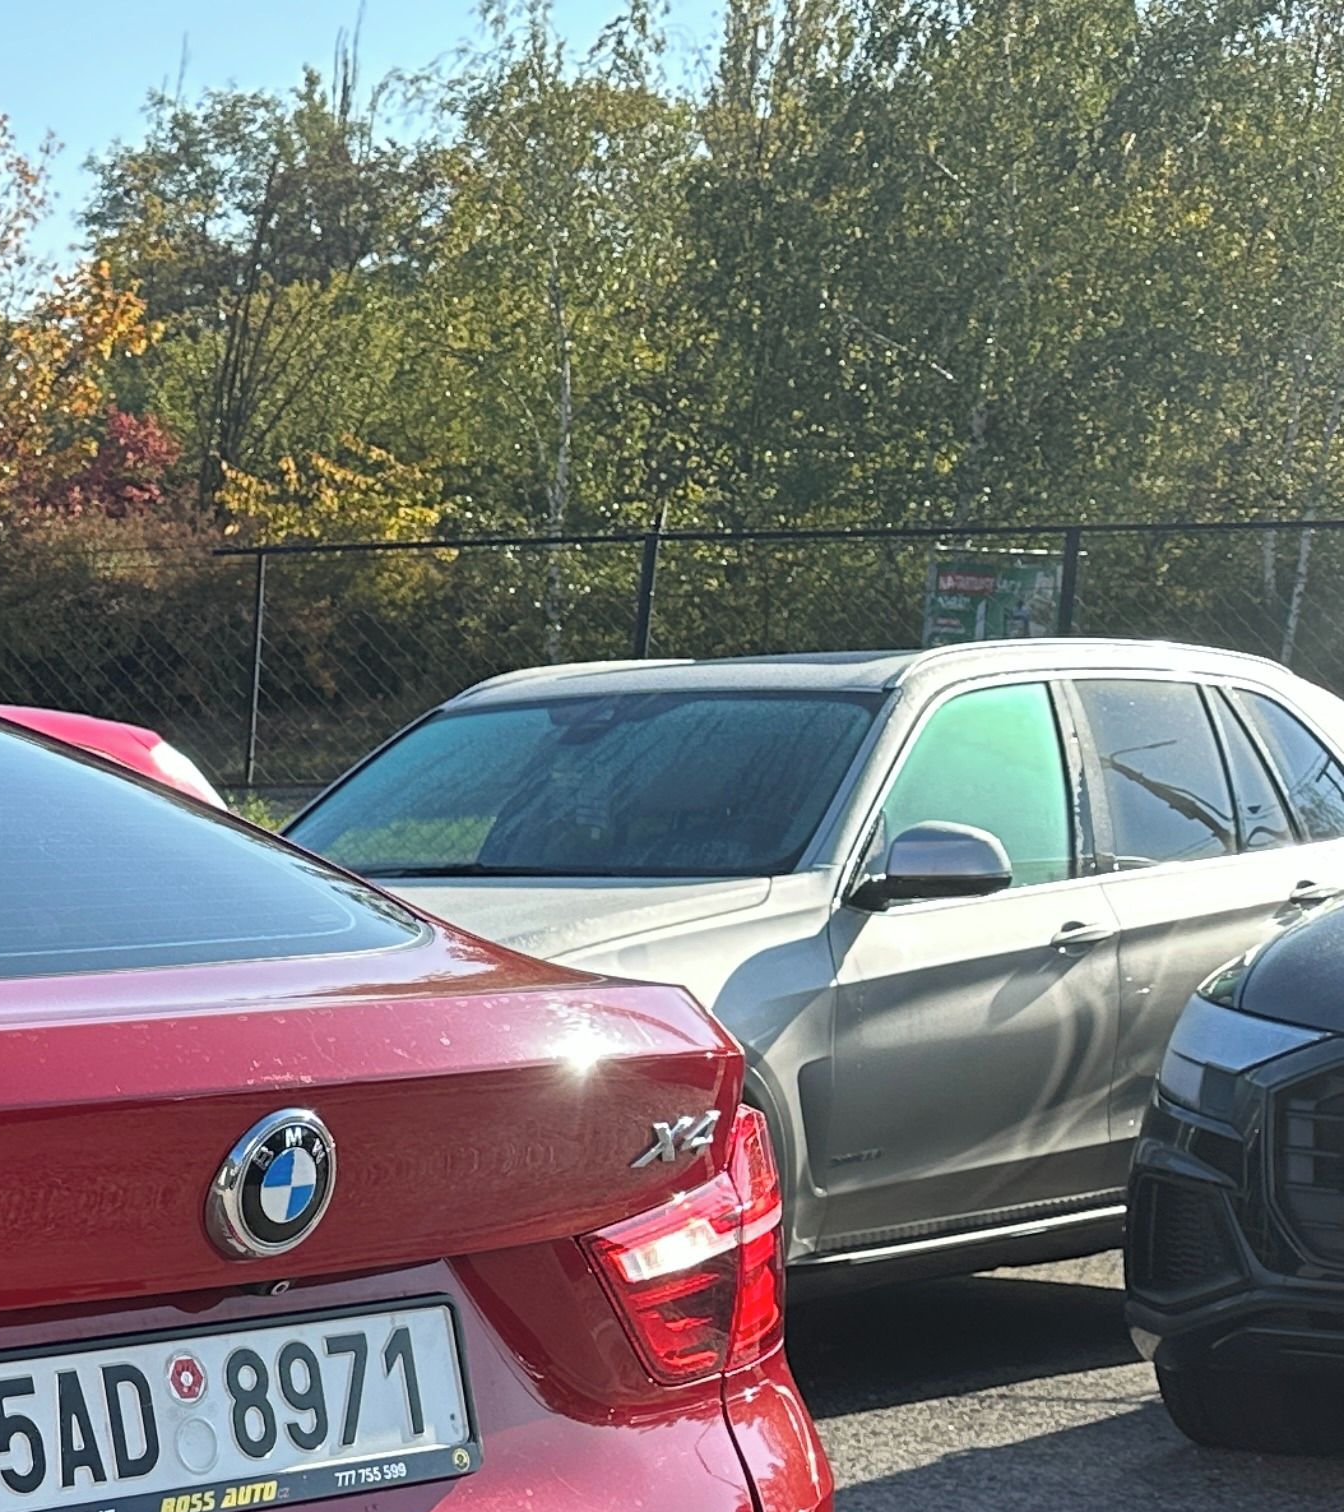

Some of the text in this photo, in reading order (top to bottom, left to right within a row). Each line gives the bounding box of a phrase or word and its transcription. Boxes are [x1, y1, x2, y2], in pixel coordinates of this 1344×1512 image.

[252, 1126, 326, 1171] BMW
[630, 1109, 722, 1168] X4
[224, 1326, 425, 1459] 8971
[220, 1480, 278, 1509] AUTO
[334, 1461, 407, 1488] 777 755 599
